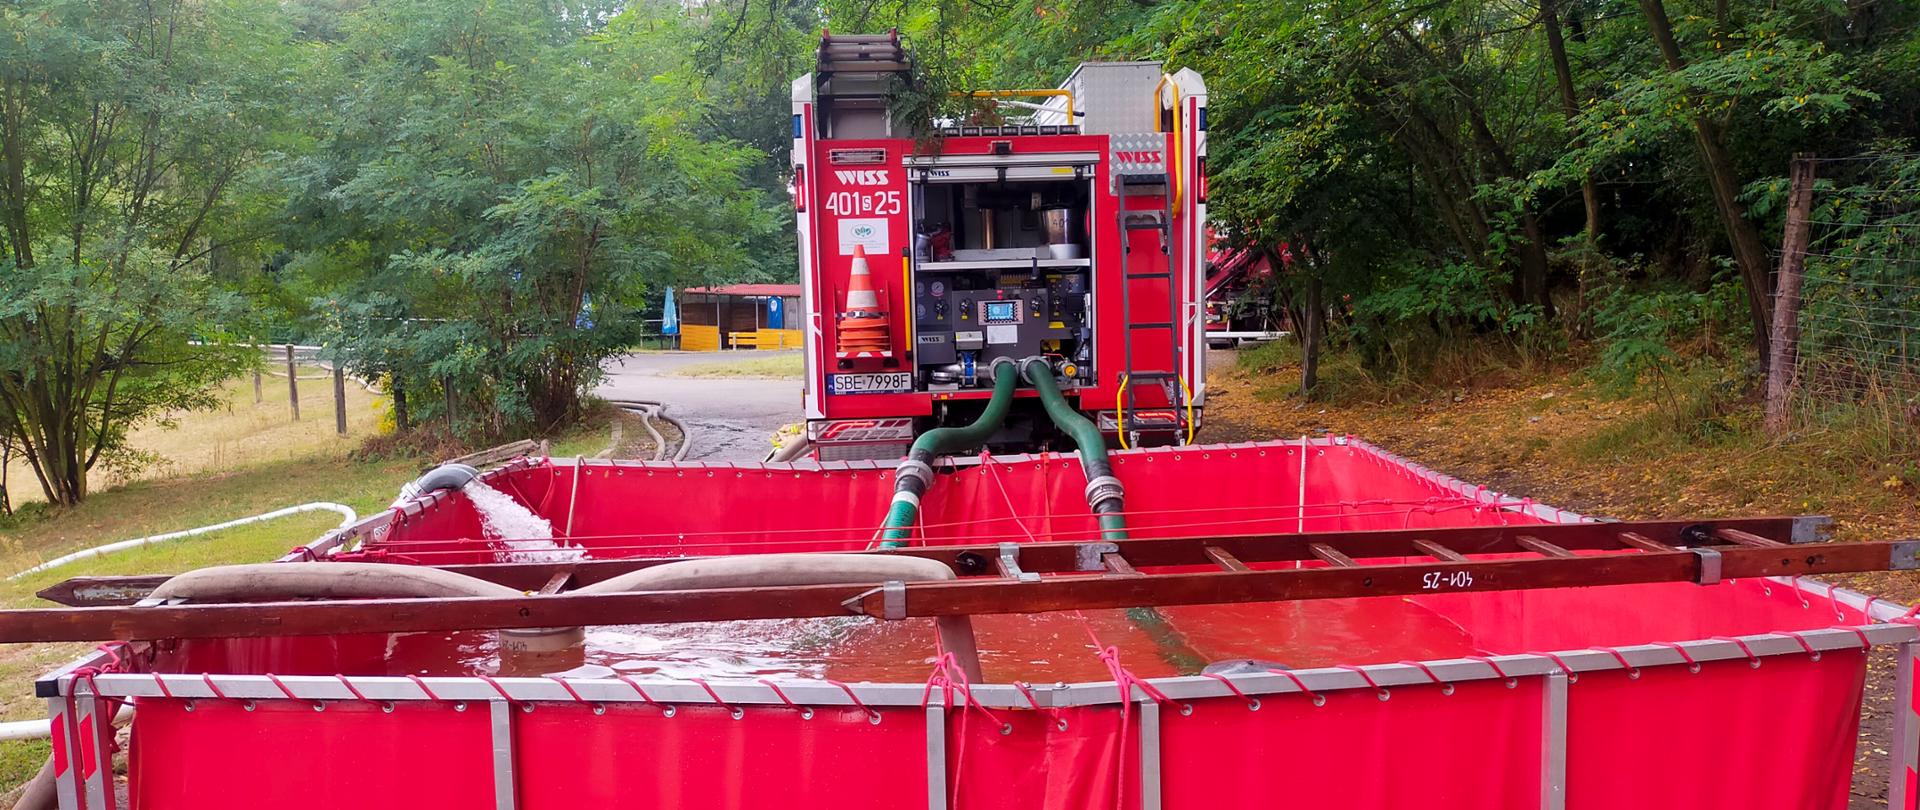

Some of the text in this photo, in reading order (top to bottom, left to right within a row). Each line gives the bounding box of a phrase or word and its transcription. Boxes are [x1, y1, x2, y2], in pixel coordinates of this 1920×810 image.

[1116, 151, 1161, 163] WISS
[834, 170, 888, 185] WISS
[825, 190, 901, 216] 401 S 25
[835, 374, 909, 390] SBE 7998F
[1422, 571, 1473, 589] 401-25
